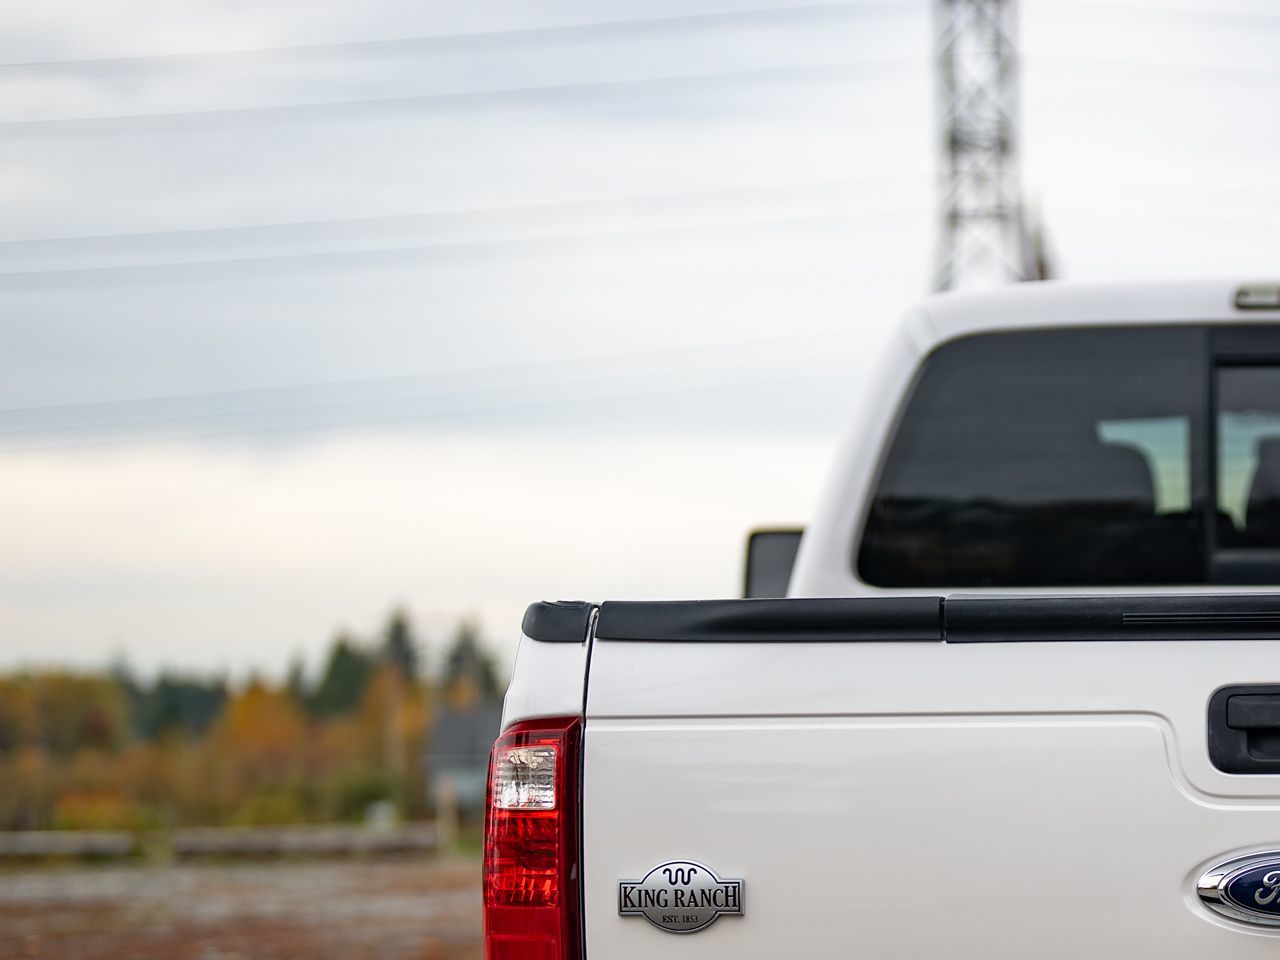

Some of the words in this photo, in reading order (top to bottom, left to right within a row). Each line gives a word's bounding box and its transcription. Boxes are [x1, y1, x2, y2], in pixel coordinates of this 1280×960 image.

[622, 886, 668, 908] KING
[674, 885, 738, 908] RANCH
[662, 915, 680, 923] EST.
[682, 915, 699, 923] 1853
